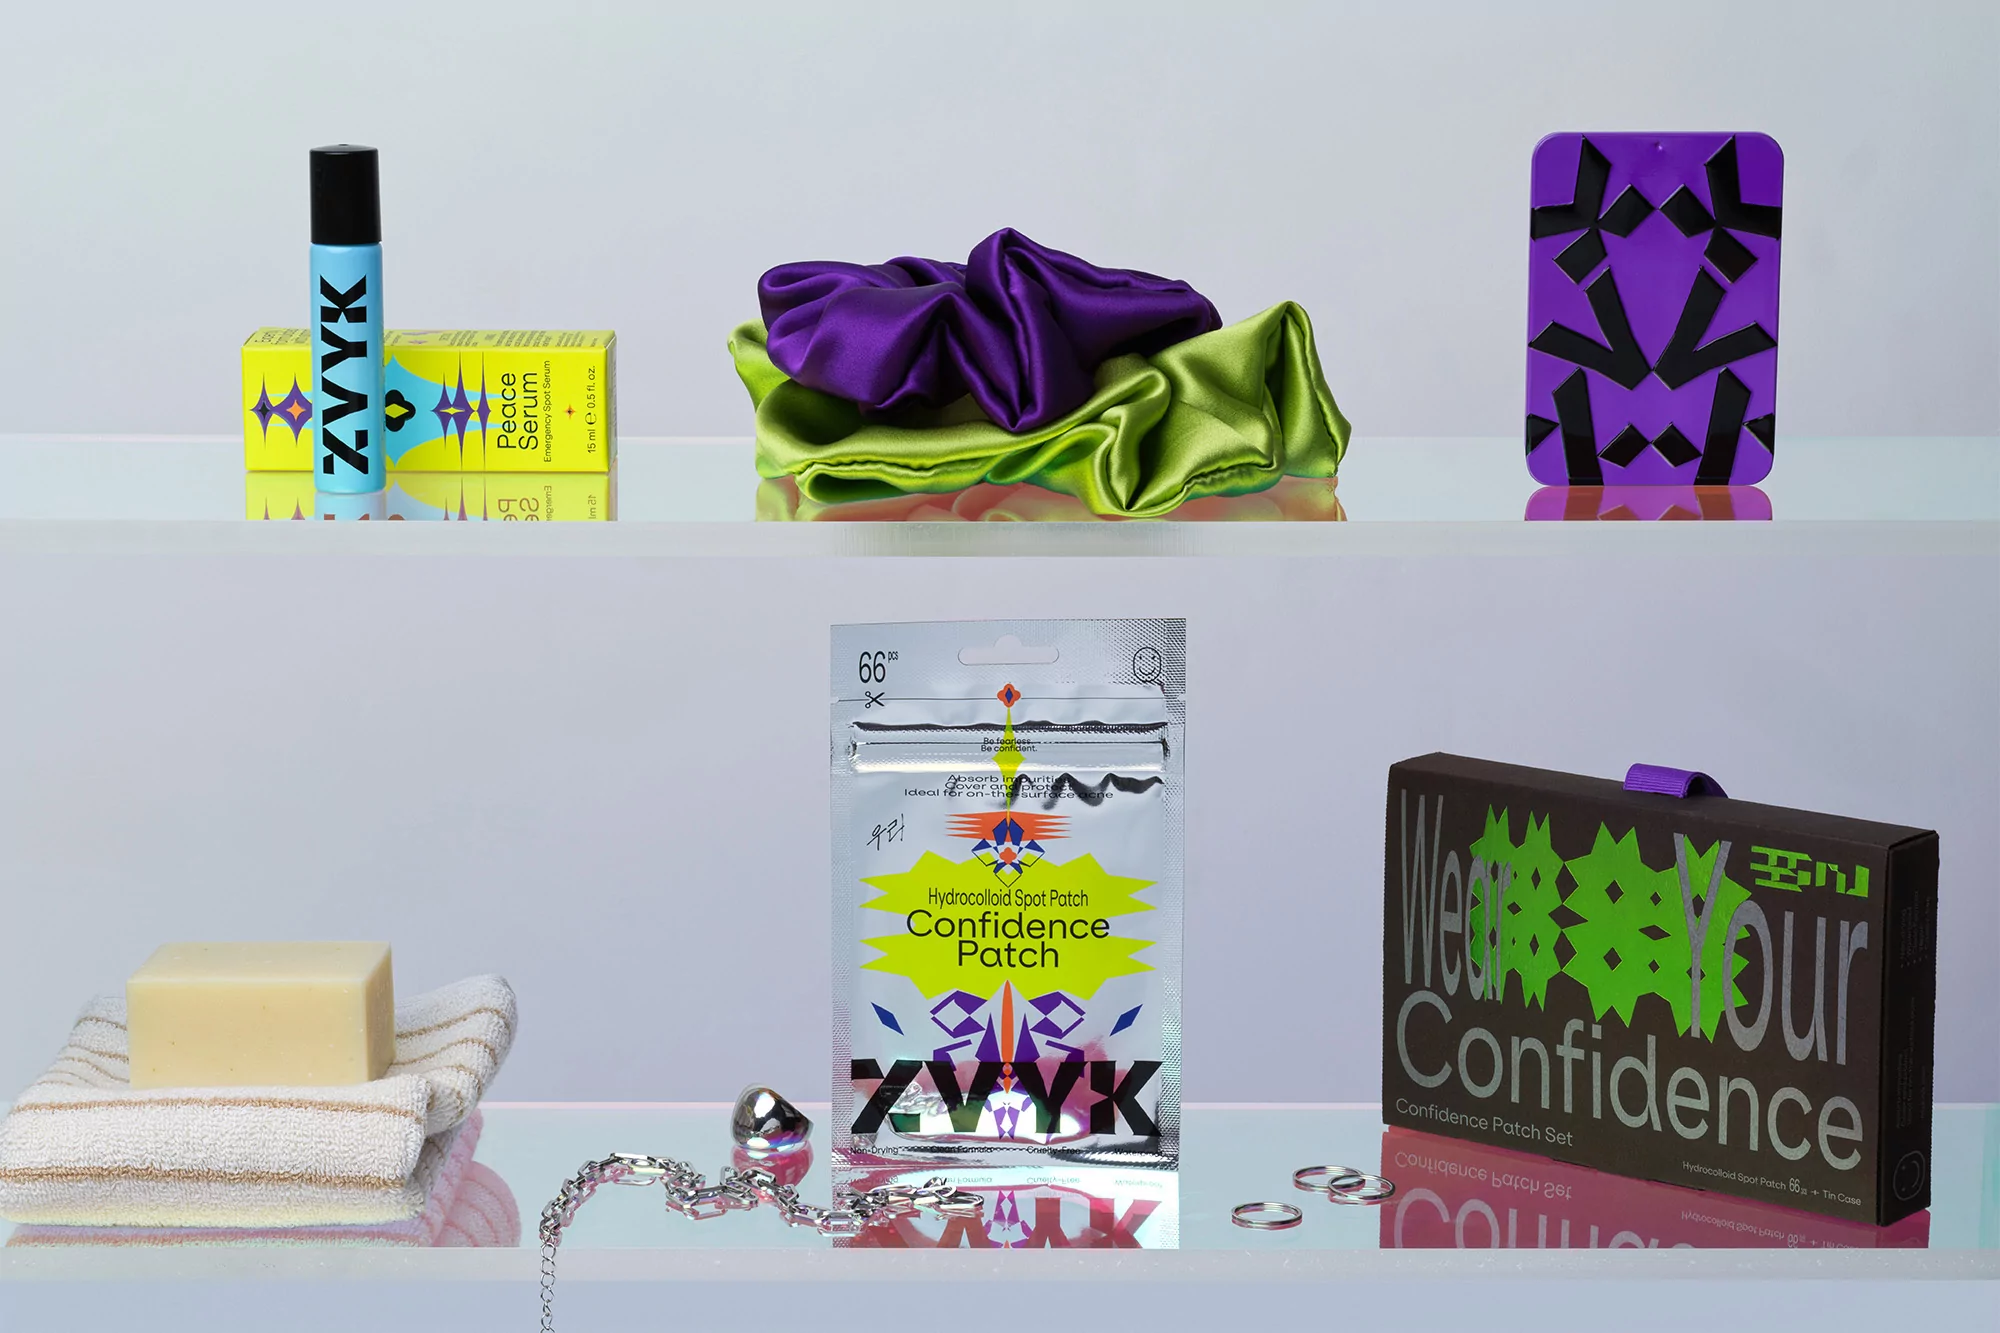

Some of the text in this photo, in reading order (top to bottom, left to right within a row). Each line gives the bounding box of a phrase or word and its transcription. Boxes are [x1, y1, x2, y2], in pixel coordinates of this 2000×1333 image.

[587, 365, 596, 381] oz.
[587, 382, 596, 392] fl.
[497, 372, 517, 449] Peace
[518, 372, 539, 450] Serum
[543, 360, 554, 463] Emergency Spot Serum
[587, 393, 596, 409] 0.5
[587, 429, 596, 440] ml
[587, 441, 597, 454] 15
[859, 650, 899, 683] 66 pcs
[983, 737, 994, 745] Be
[945, 782, 1073, 793] Cover and protect
[947, 774, 999, 783] Absorb
[904, 788, 1113, 799] Ideal for on-the-surface acne
[928, 887, 1089, 911] Hydrocolloid Spot Patch
[906, 909, 1110, 940] Confidence
[1401, 788, 1512, 1001] Wear
[1673, 832, 1868, 1065] Your
[957, 940, 1059, 968] Patch
[1396, 990, 1863, 1170] Confidence
[1396, 1098, 1573, 1146] Confidence Patch Set
[851, 1145, 899, 1155] Non-Drying
[1682, 1160, 1736, 1180] Hydrocolloid
[1737, 1172, 1759, 1185] Spot
[1760, 1177, 1786, 1190] Patch
[1789, 1177, 1800, 1193] 66
[1822, 1189, 1836, 1200] Tin
[1837, 1193, 1862, 1205] Case
